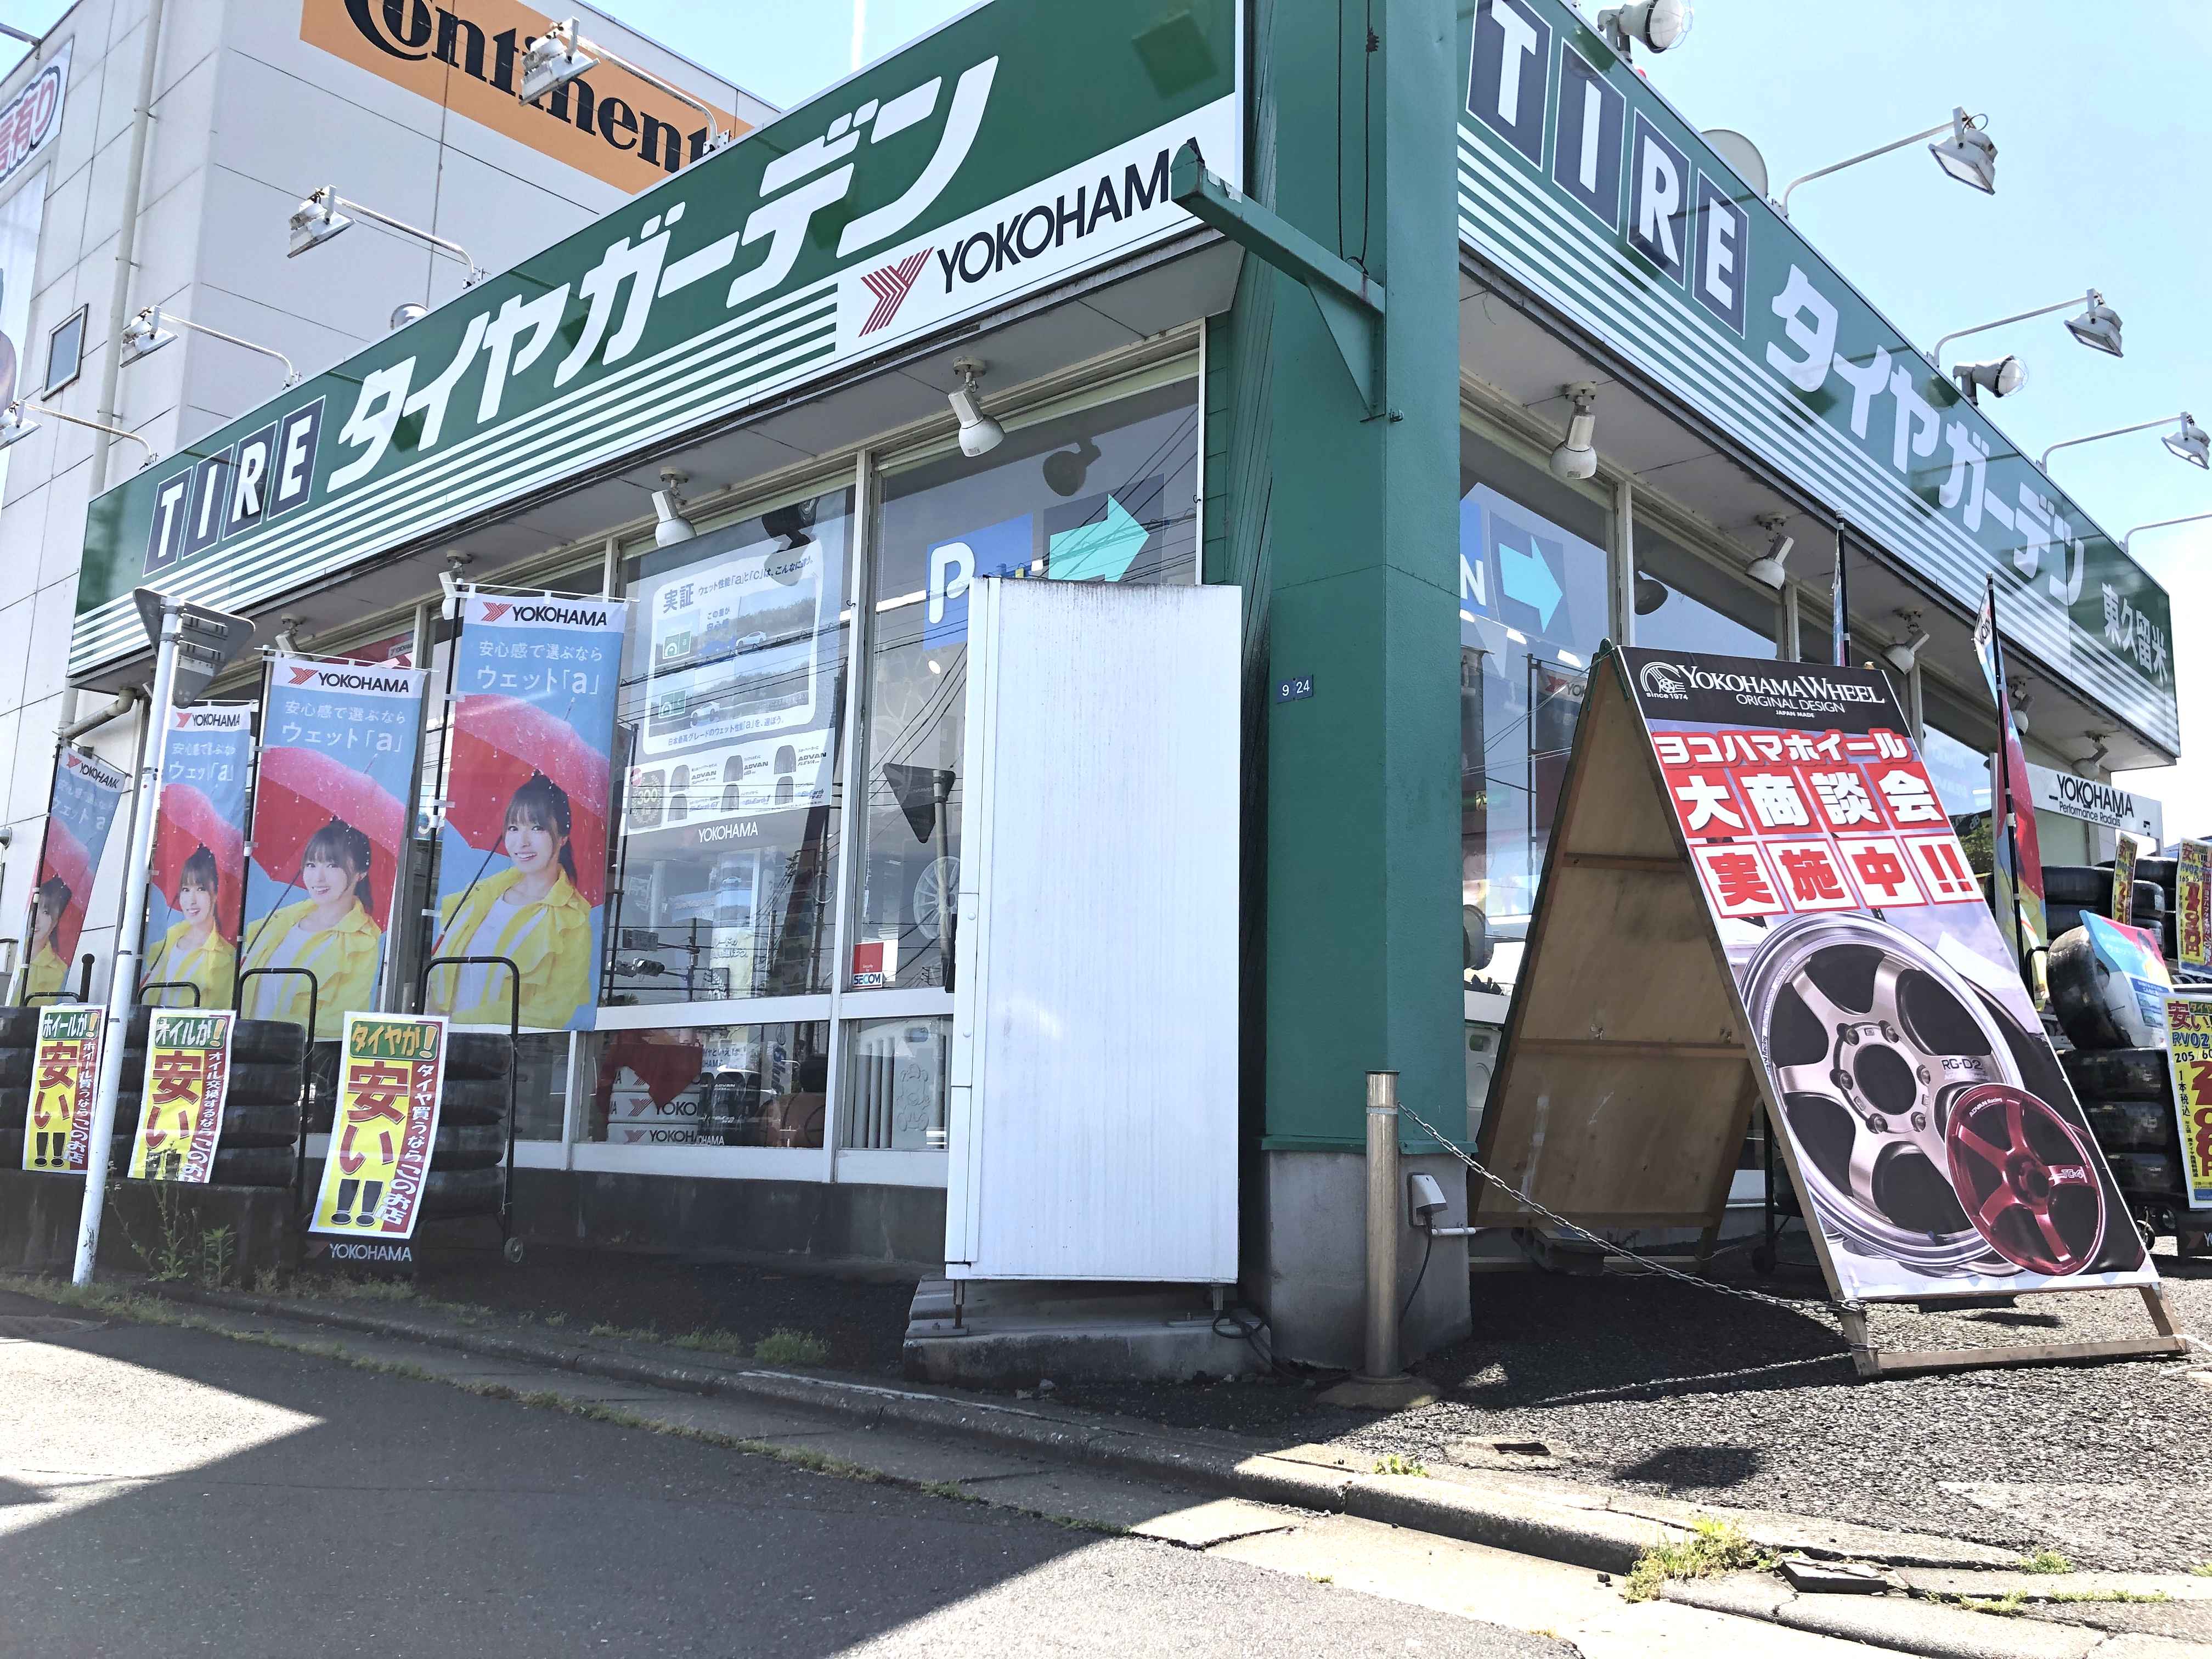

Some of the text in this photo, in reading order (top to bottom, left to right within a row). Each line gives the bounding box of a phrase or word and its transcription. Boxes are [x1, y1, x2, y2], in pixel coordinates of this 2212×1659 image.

[1490, 0, 1735, 310] TIRE
[327, 55, 999, 493] タイヤガーデン
[1766, 264, 2084, 606] タイヤガーデン
[157, 415, 312, 558] TIRE
[929, 542, 975, 623] P
[663, 583, 694, 614] 実証
[512, 606, 607, 627] YOKOHAMA
[2102, 583, 2168, 681] 東久留米
[479, 641, 603, 662] 安心感で選ぶなら
[318, 672, 409, 693] YOKOHAMA
[477, 668, 600, 695] ウェット「a」
[1282, 680, 1310, 696] 9 24
[1677, 664, 1807, 698] YOKOHAMA
[285, 700, 405, 724] 安心感で選ぶなら
[1736, 694, 1846, 713] ORIGINAL DESIGN
[193, 713, 240, 727] YOKOHAMA
[798, 752, 827, 761] ADVAN
[1655, 733, 1908, 764] ヨコハマホイール
[691, 770, 716, 780] ADVAN
[744, 761, 768, 770] ADVAN
[1675, 770, 1944, 831] 大商談会
[2057, 774, 2134, 817] YOKOHAMA
[2059, 802, 2120, 827] Performance Radials
[698, 821, 758, 843] YOKOHAMA
[854, 974, 881, 984] SECOM
[2172, 1032, 2210, 1048] RV02
[1941, 1058, 1984, 1070] RG-D2
[1968, 1100, 1988, 1117] ADVAN
[329, 1243, 412, 1262] YOKOHAMA
